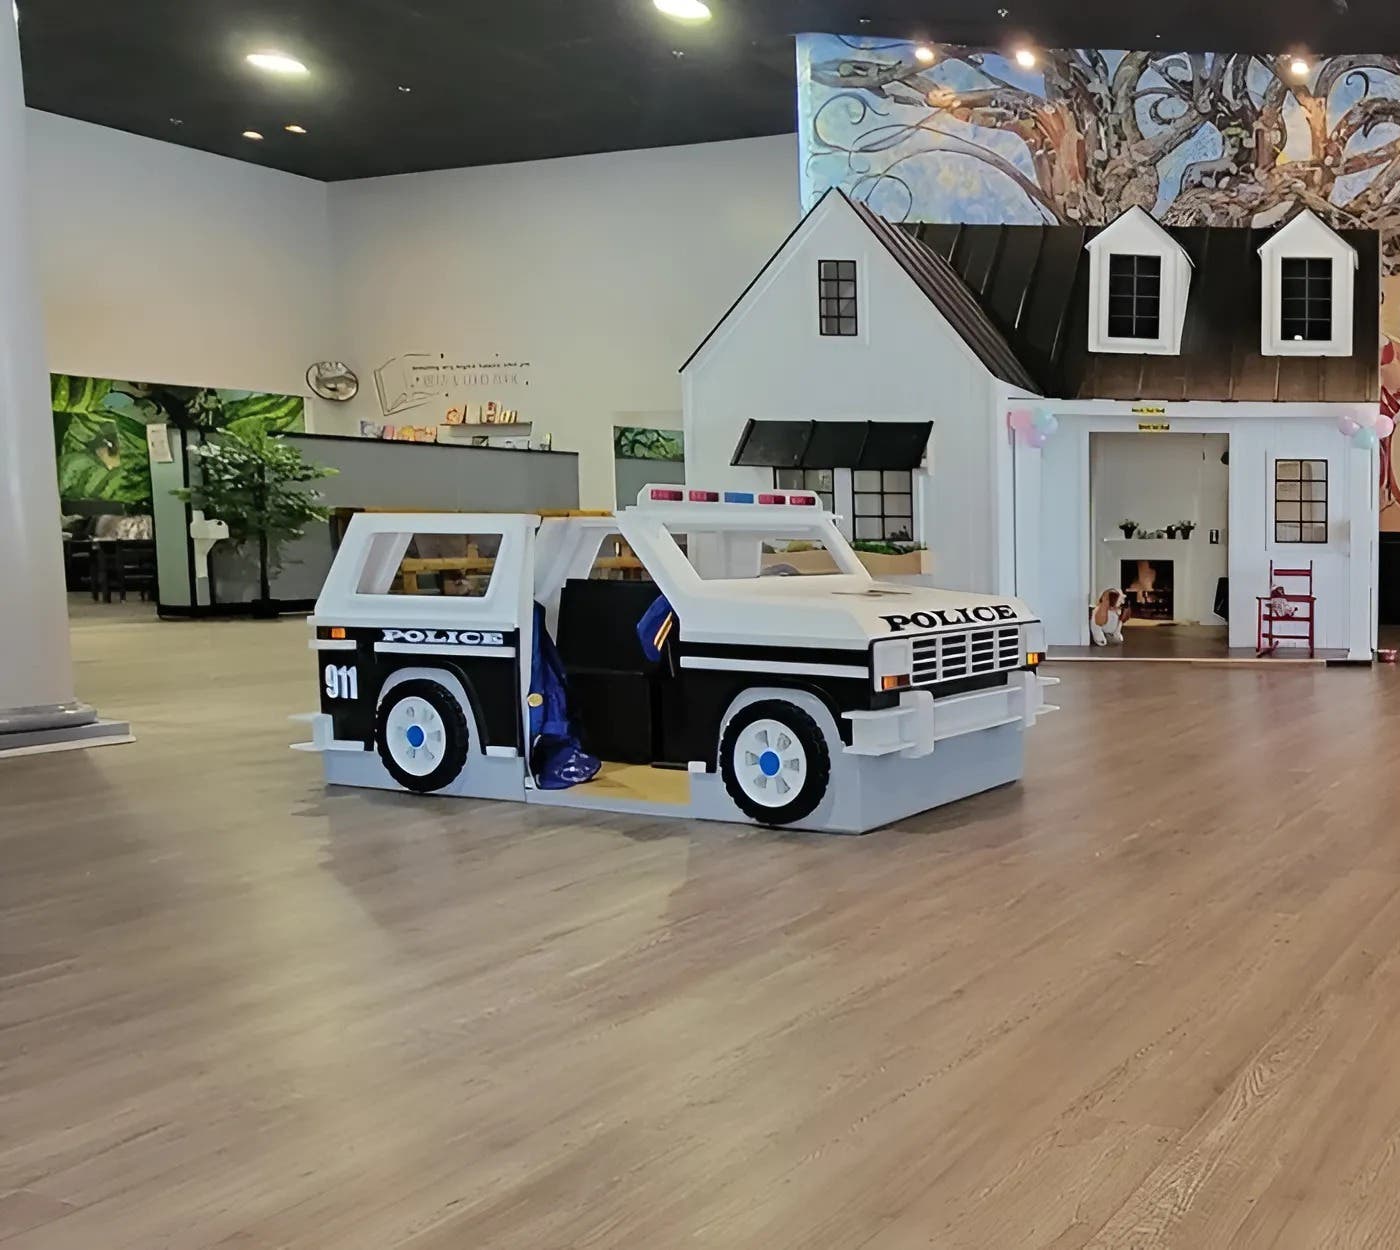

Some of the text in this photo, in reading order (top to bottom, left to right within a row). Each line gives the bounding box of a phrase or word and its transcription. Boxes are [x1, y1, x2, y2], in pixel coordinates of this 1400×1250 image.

[878, 604, 1018, 632] POLICE
[382, 629, 504, 645] POLICE
[325, 663, 358, 700] 911
